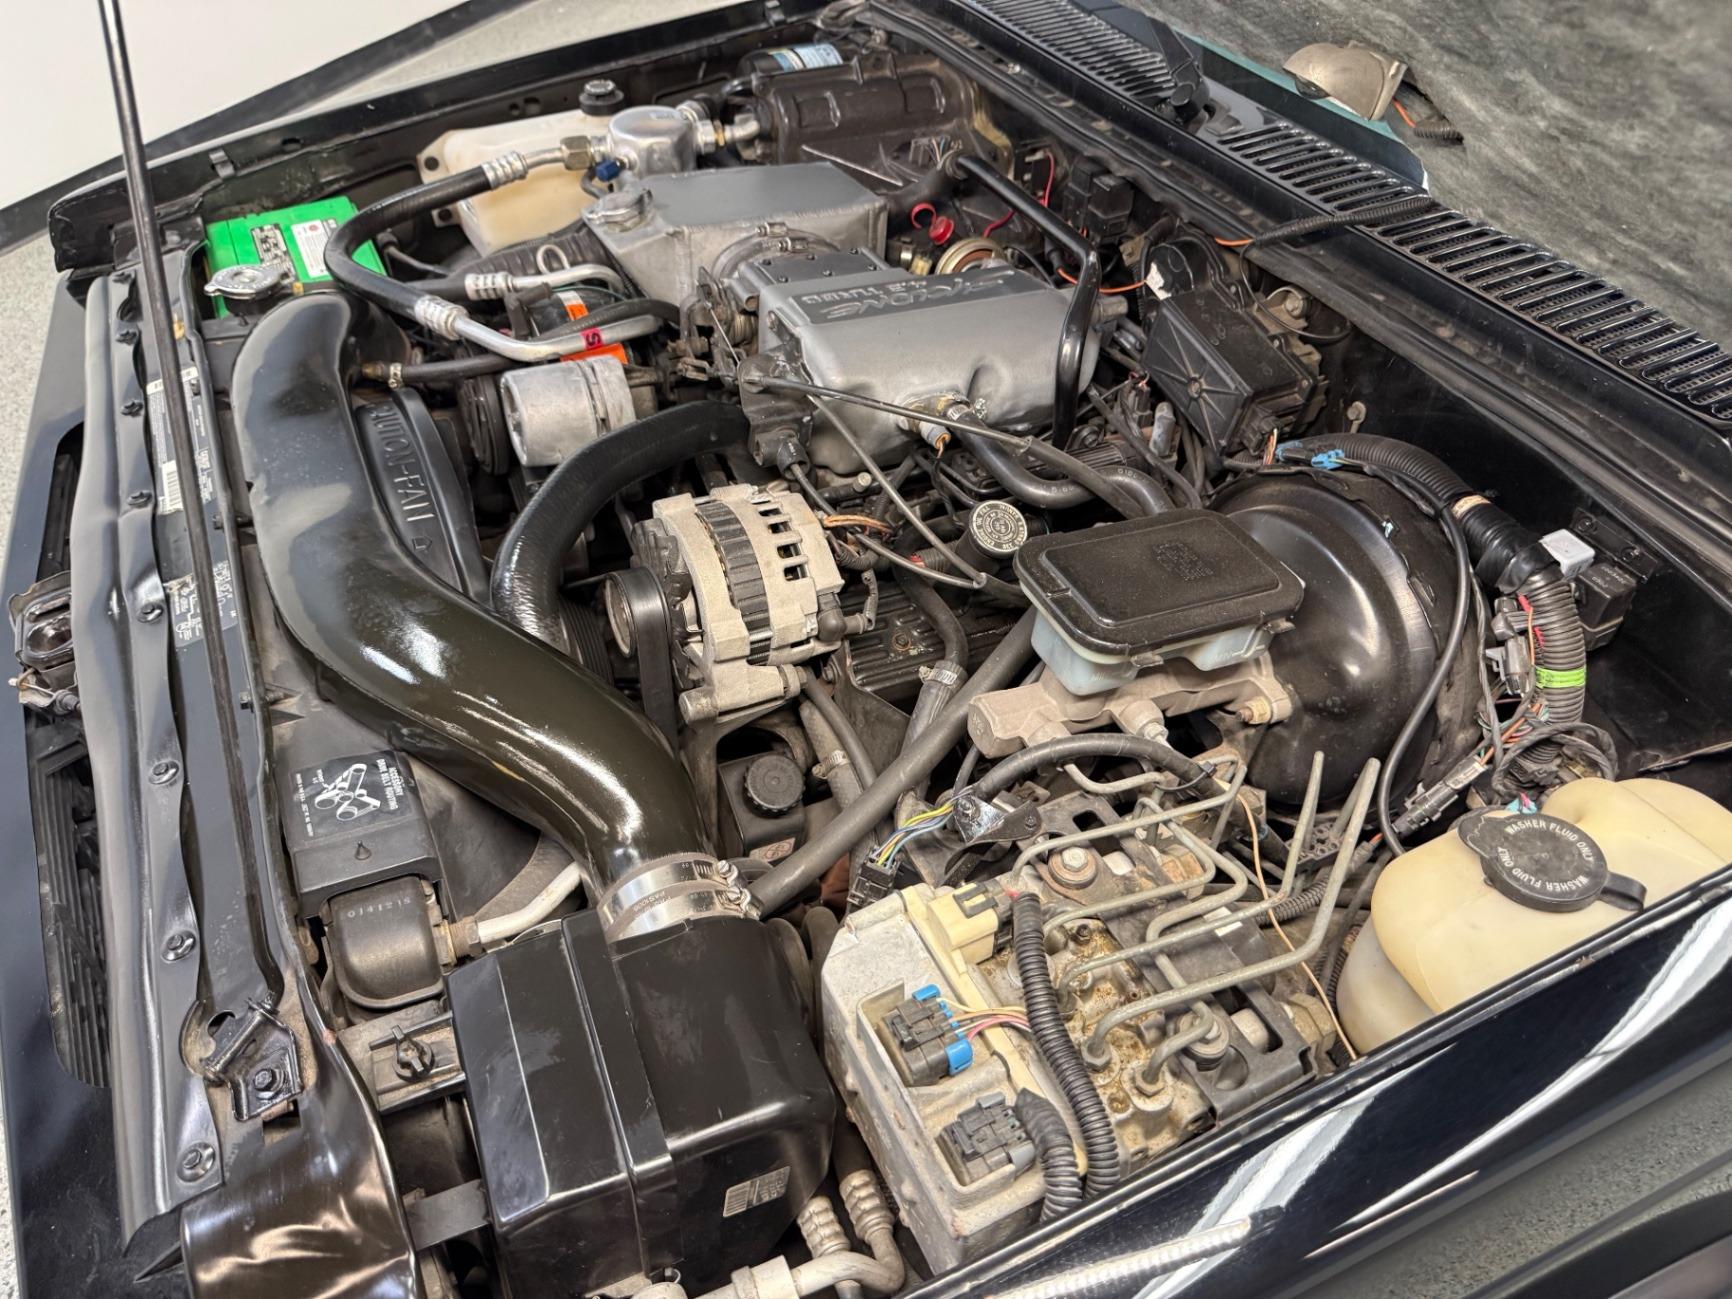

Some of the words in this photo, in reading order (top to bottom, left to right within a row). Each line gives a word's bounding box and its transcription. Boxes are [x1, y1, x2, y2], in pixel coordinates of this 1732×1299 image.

[1505, 818, 1547, 835] WASHER
[1549, 822, 1578, 842] FLUID
[1576, 841, 1595, 862] ONLY
[1498, 846, 1514, 868] ONLY
[1512, 867, 1542, 888] FLUID
[1546, 874, 1590, 892] WASHER
